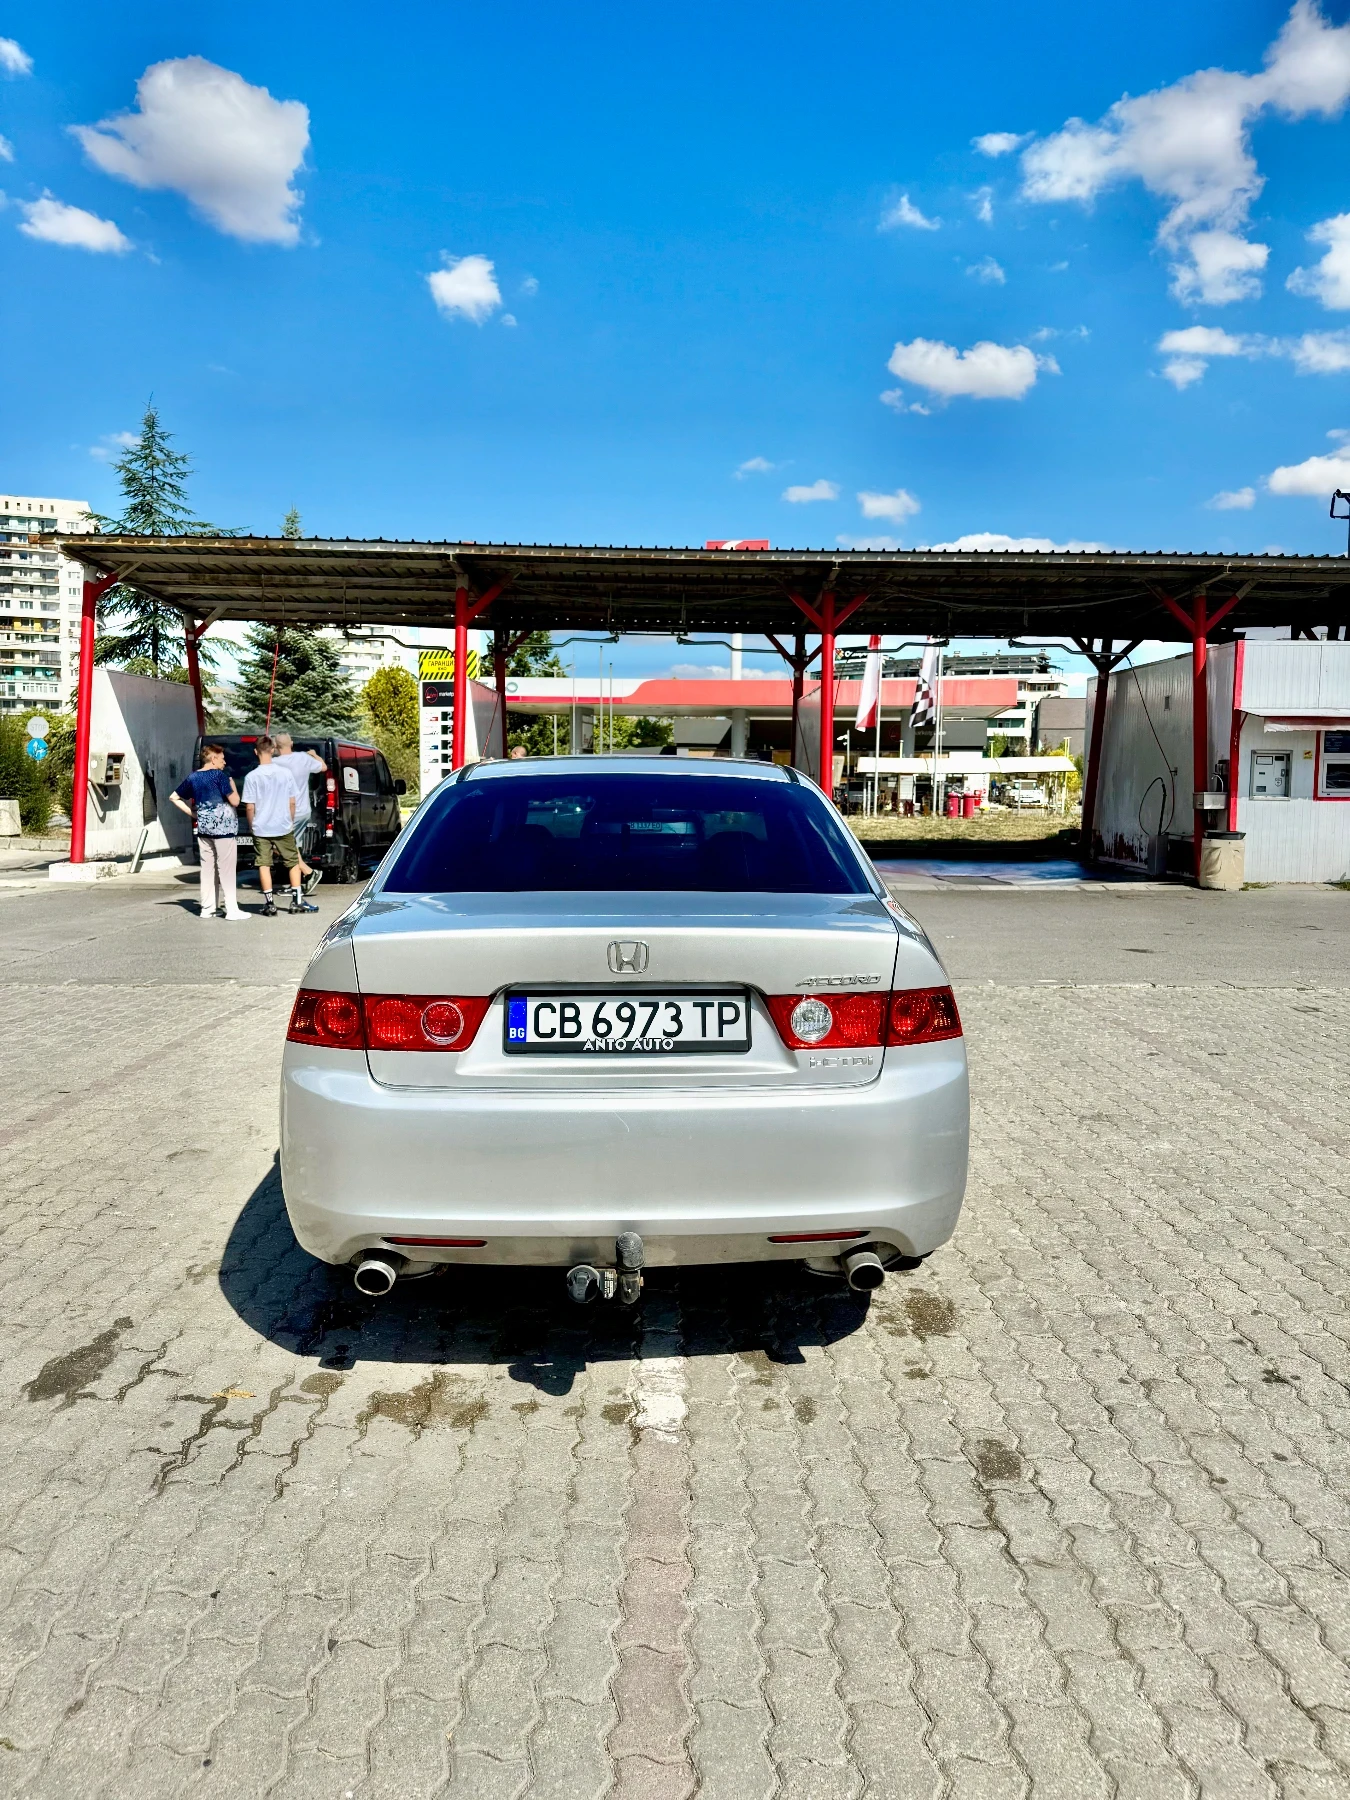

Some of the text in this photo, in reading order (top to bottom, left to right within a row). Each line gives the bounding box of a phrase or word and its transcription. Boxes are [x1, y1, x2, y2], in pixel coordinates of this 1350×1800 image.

[30, 723, 48, 732] STOP
[795, 973, 881, 987] ACCORD
[533, 1002, 741, 1039] CB 6973 TP
[509, 1027, 525, 1039] BG
[582, 1038, 675, 1051] ANTO AUTO
